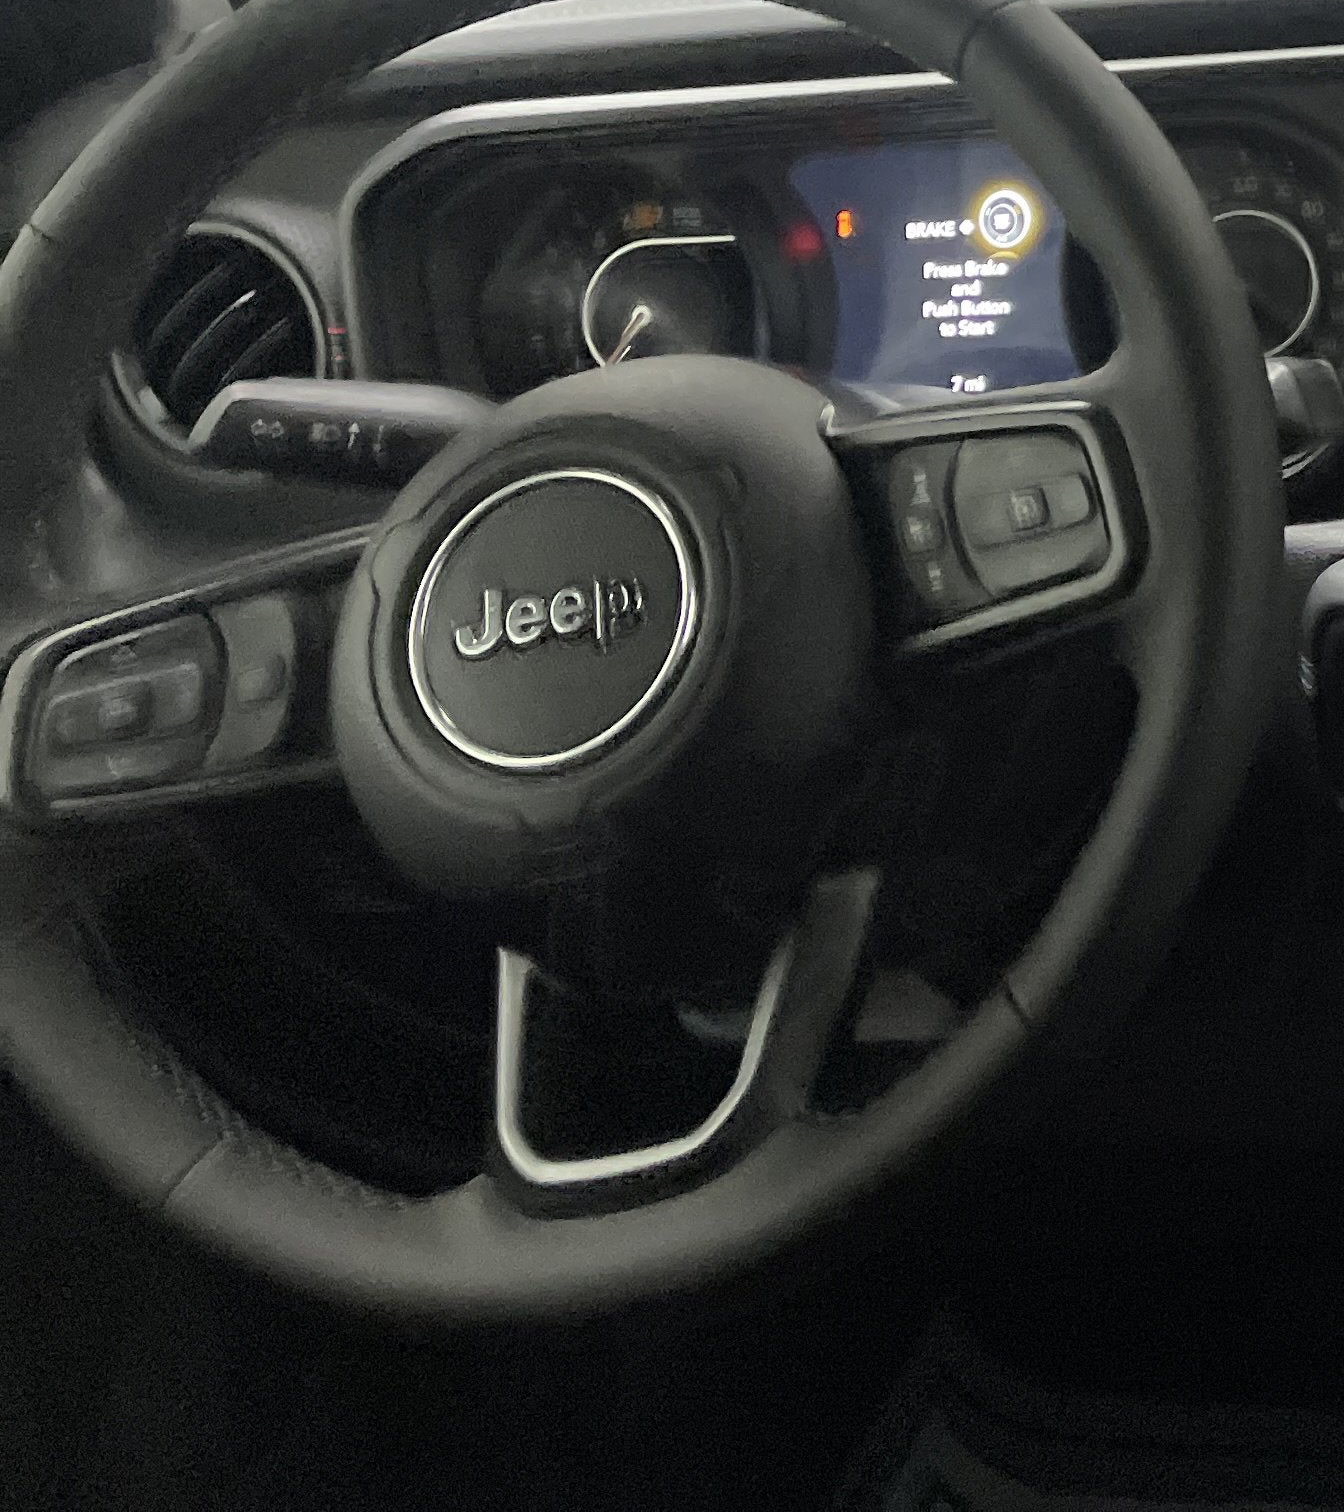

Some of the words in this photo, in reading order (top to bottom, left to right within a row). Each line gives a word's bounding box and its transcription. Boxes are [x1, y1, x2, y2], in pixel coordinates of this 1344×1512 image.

[905, 219, 957, 239] BRAKE
[964, 260, 1009, 276] Brake
[950, 279, 982, 297] and
[922, 300, 958, 318] Push
[960, 299, 1011, 316] Button
[939, 320, 956, 338] to
[959, 318, 995, 336] Start
[453, 576, 647, 661] Jeep
